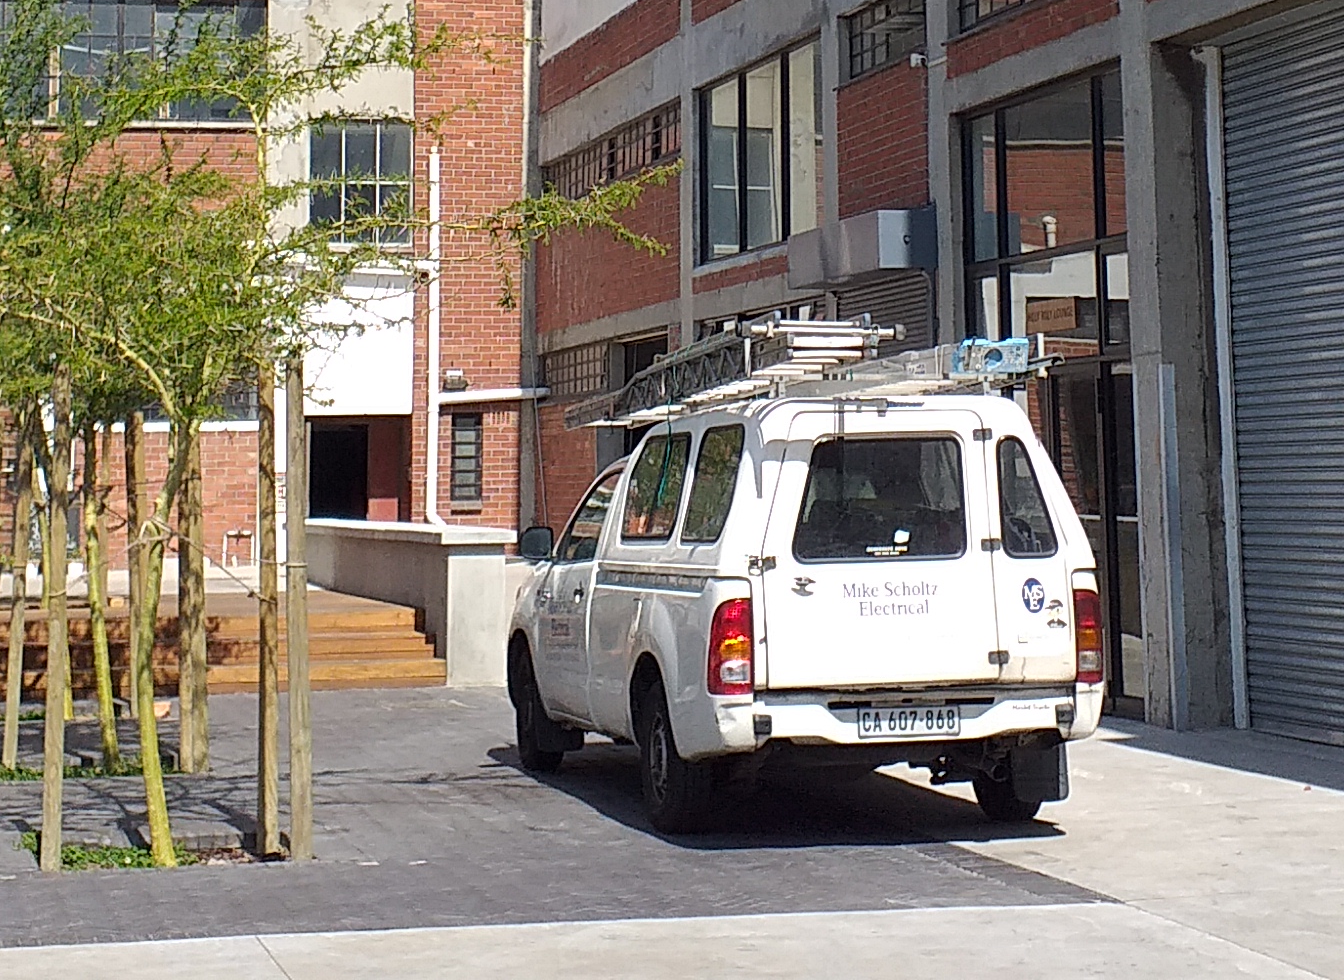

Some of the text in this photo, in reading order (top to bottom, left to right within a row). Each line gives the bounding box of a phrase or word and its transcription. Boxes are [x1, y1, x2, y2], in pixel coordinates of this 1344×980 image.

[843, 581, 938, 598] Mike Scholtz
[859, 599, 929, 617] Electrical
[862, 711, 882, 732] CA
